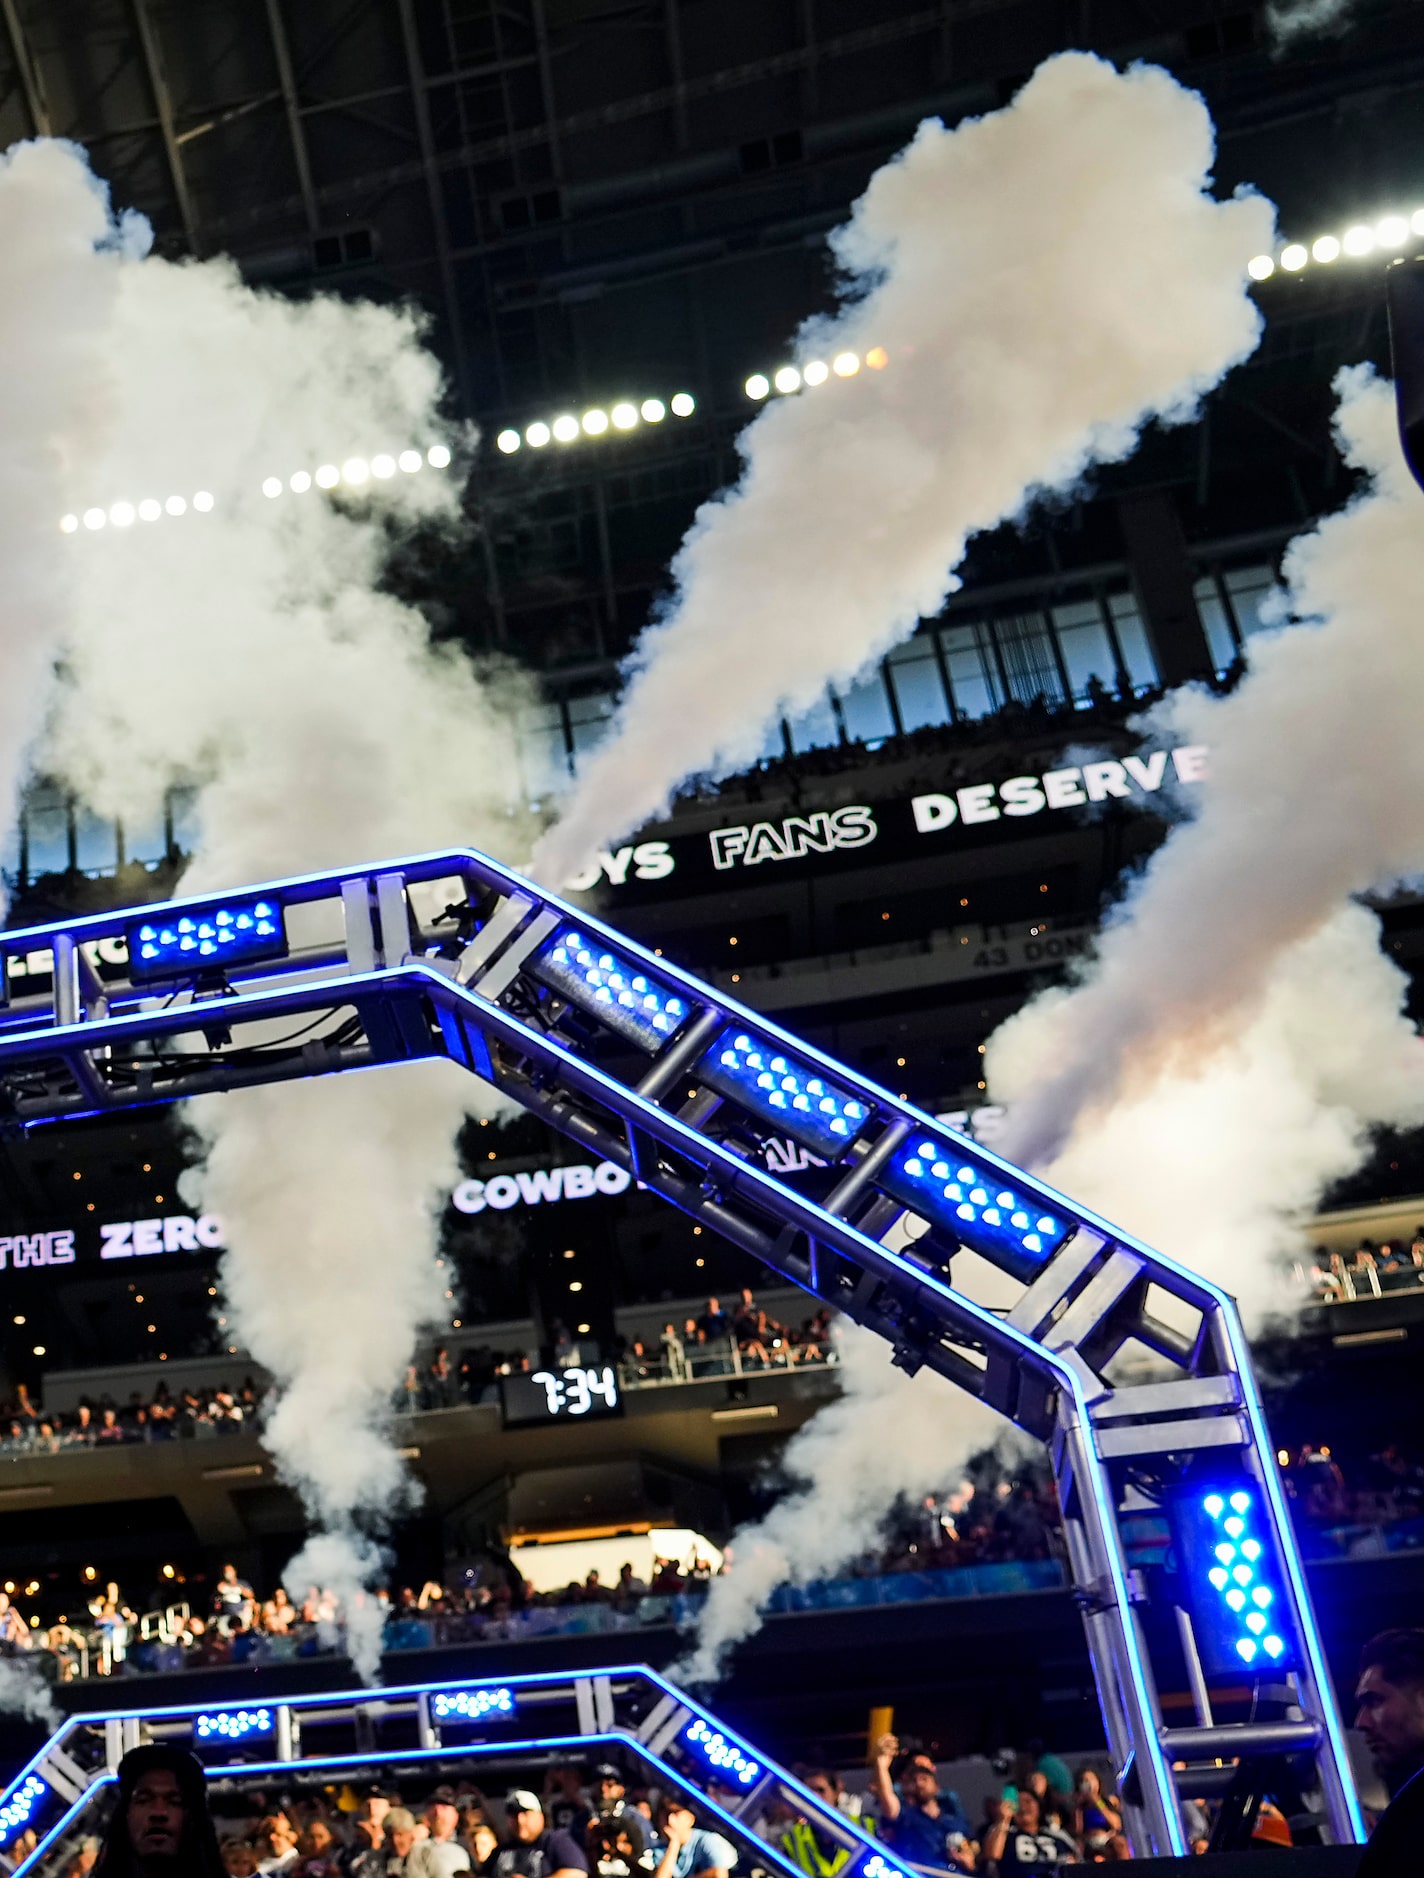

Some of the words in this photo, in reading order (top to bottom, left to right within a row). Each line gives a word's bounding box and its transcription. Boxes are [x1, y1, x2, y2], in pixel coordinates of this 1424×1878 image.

[710, 807, 877, 870] FANS
[911, 746, 1210, 833] DESERVE
[973, 947, 1009, 967] 43
[99, 1214, 226, 1260] ZERO
[452, 1160, 648, 1214] COWBO
[531, 1366, 617, 1415] 7:34
